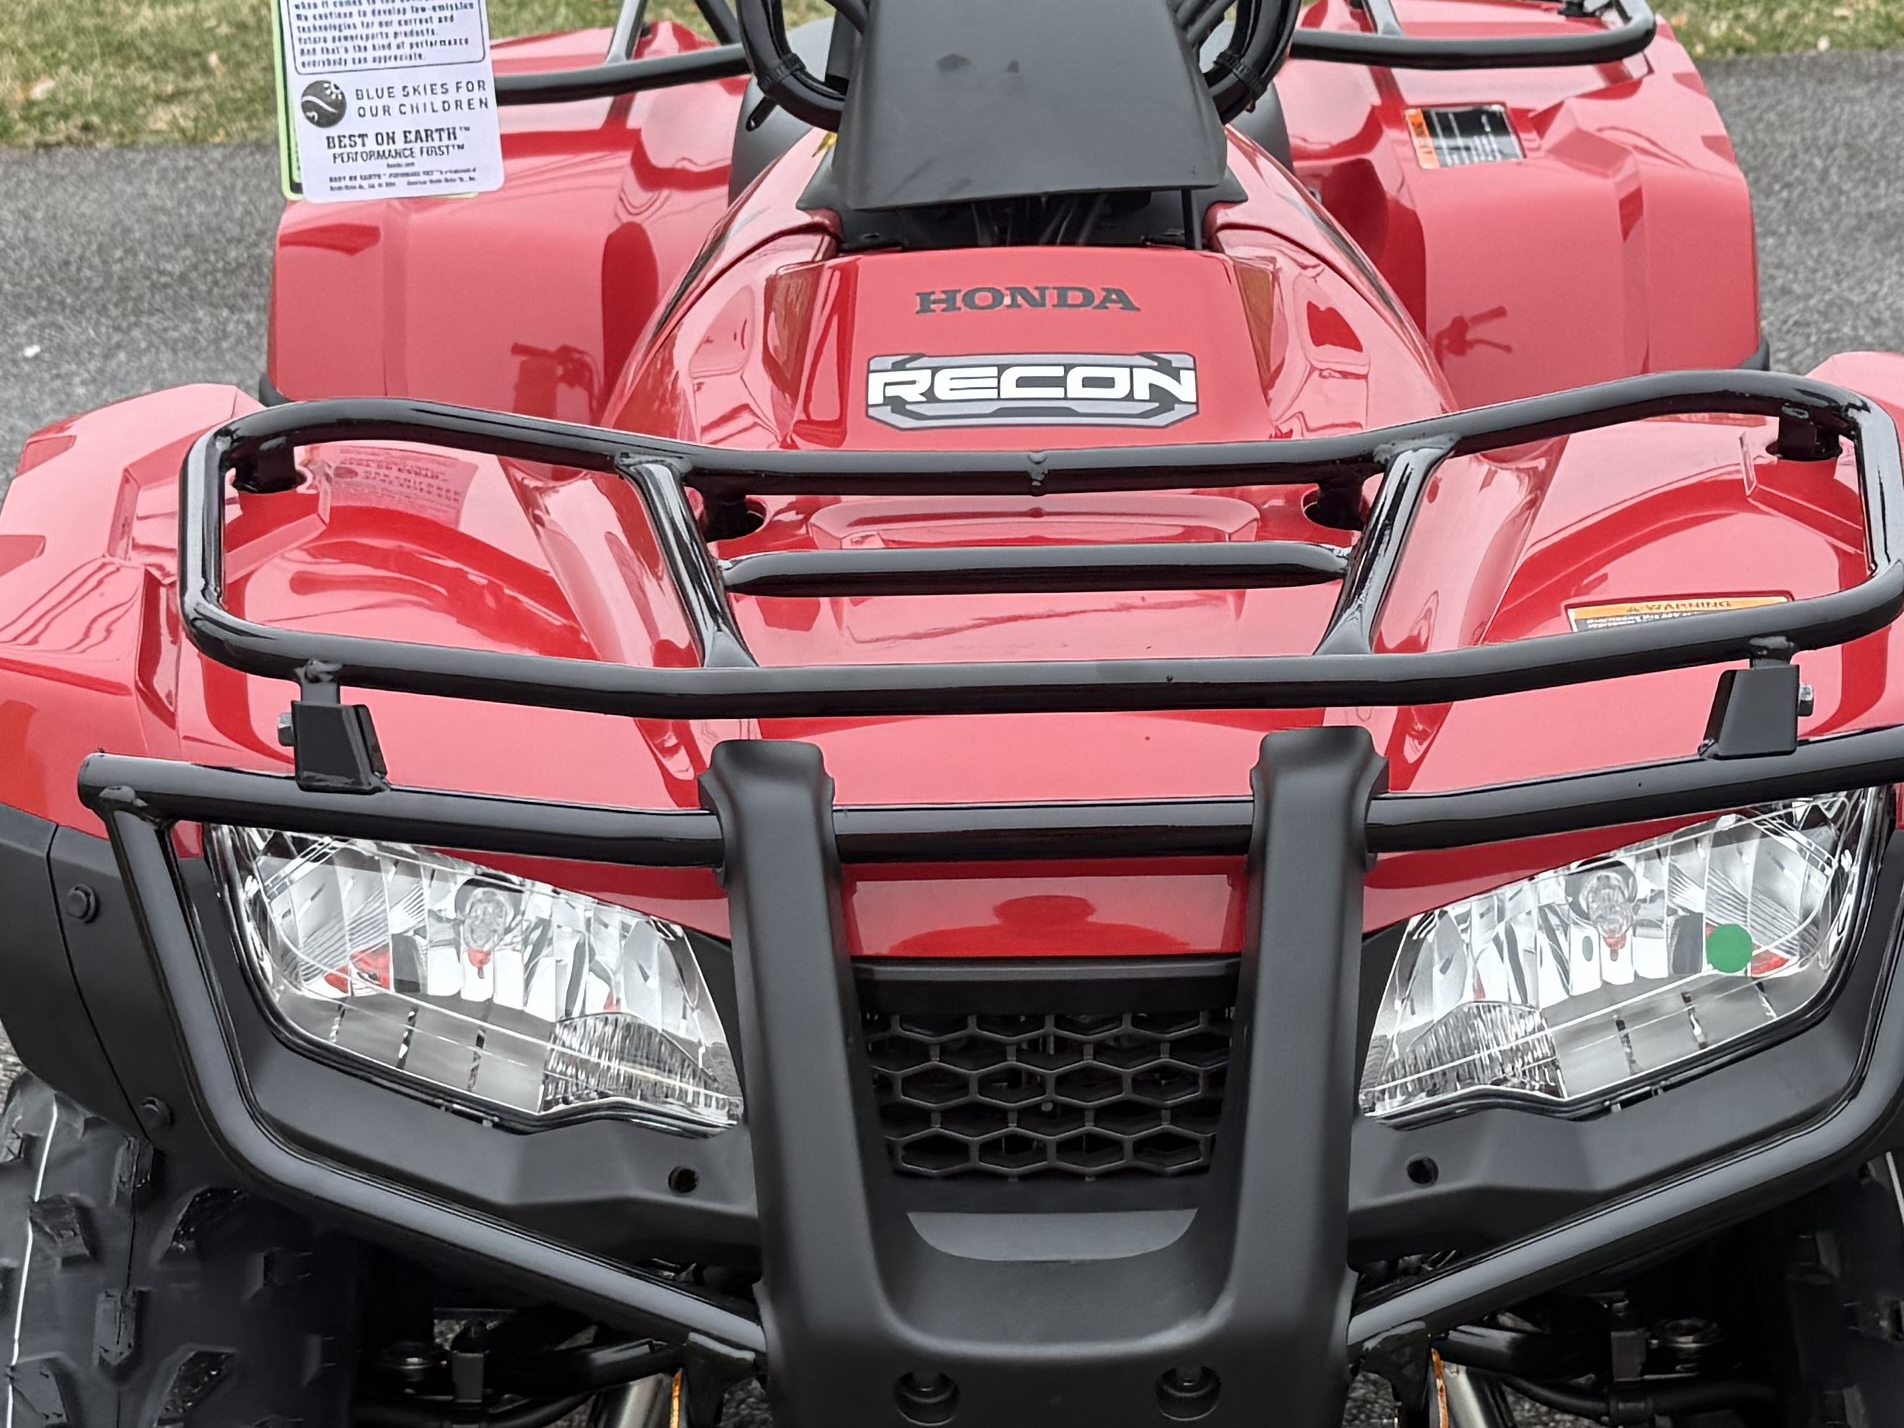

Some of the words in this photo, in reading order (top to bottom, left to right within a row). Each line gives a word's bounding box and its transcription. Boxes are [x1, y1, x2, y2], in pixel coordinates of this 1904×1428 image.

[354, 86, 395, 101] BLUE
[400, 81, 449, 97] SKIES
[454, 79, 486, 93] FOR
[356, 104, 391, 118] OUR
[398, 96, 488, 115] CHILDREN
[325, 132, 369, 150] BEST
[374, 130, 396, 146] ON
[332, 146, 415, 164] PERFORMANCE
[915, 286, 1141, 315] HONDA
[867, 365, 1198, 405] RECON
[1645, 600, 1733, 611] WARNING
